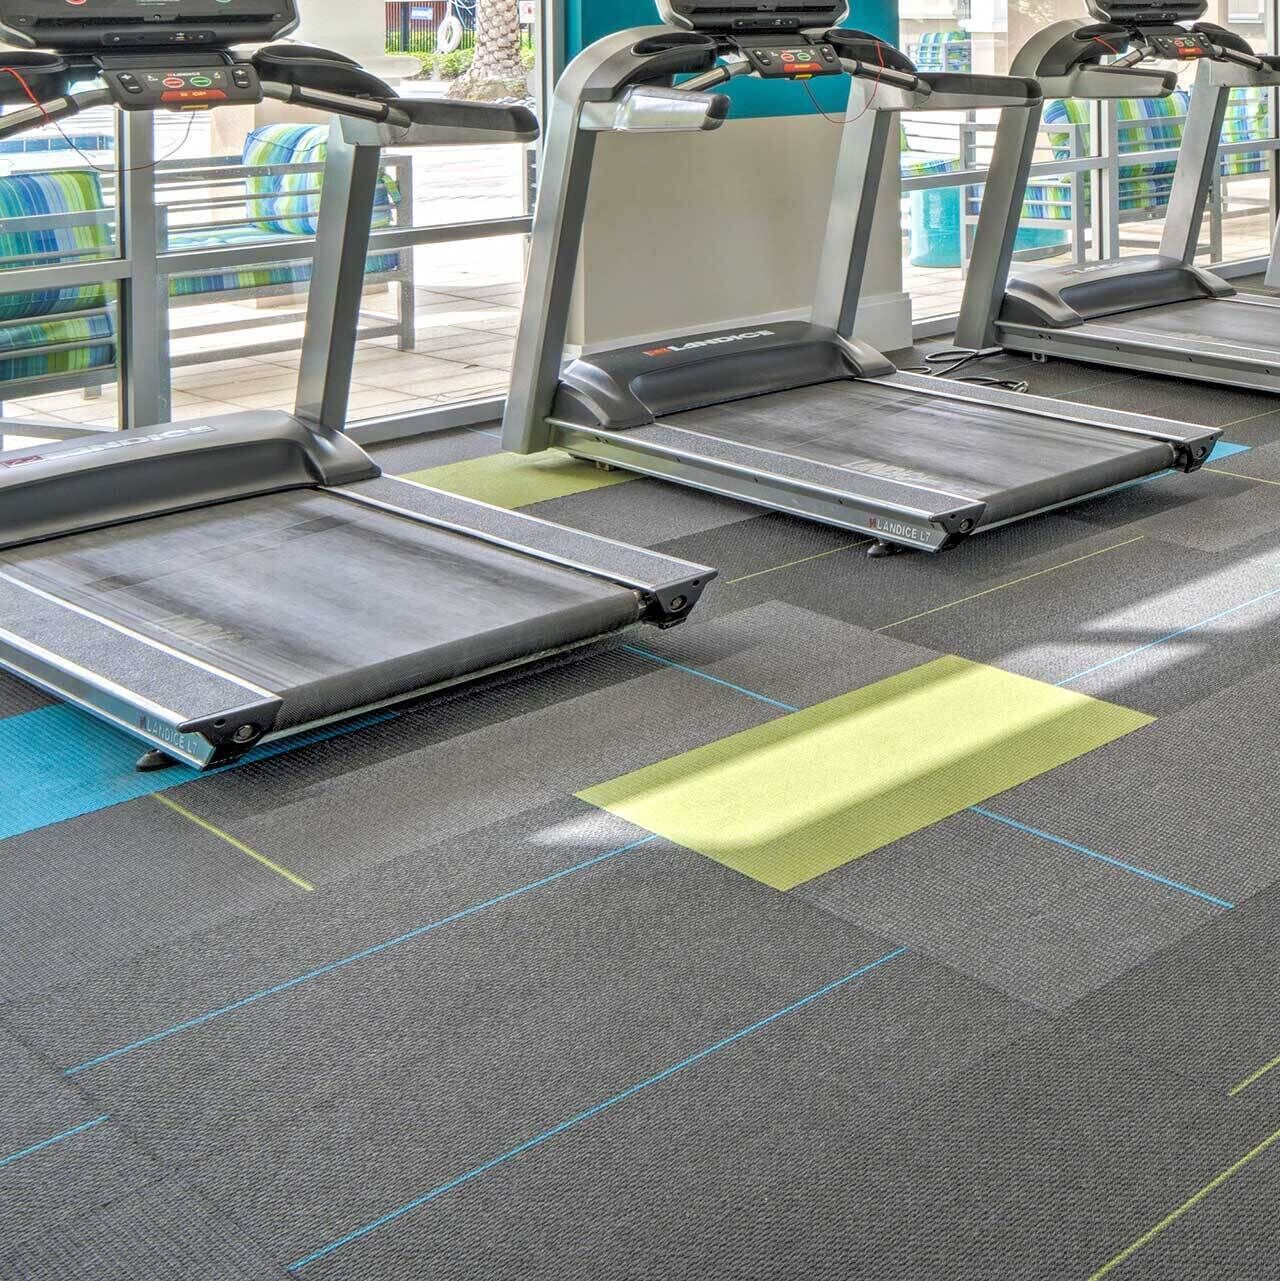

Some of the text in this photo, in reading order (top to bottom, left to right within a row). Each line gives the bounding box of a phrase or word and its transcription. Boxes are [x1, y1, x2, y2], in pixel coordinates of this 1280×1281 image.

[667, 330, 776, 352] LANDICE
[877, 520, 931, 542] LANDICE L7
[146, 719, 198, 754] LANDICE L7
